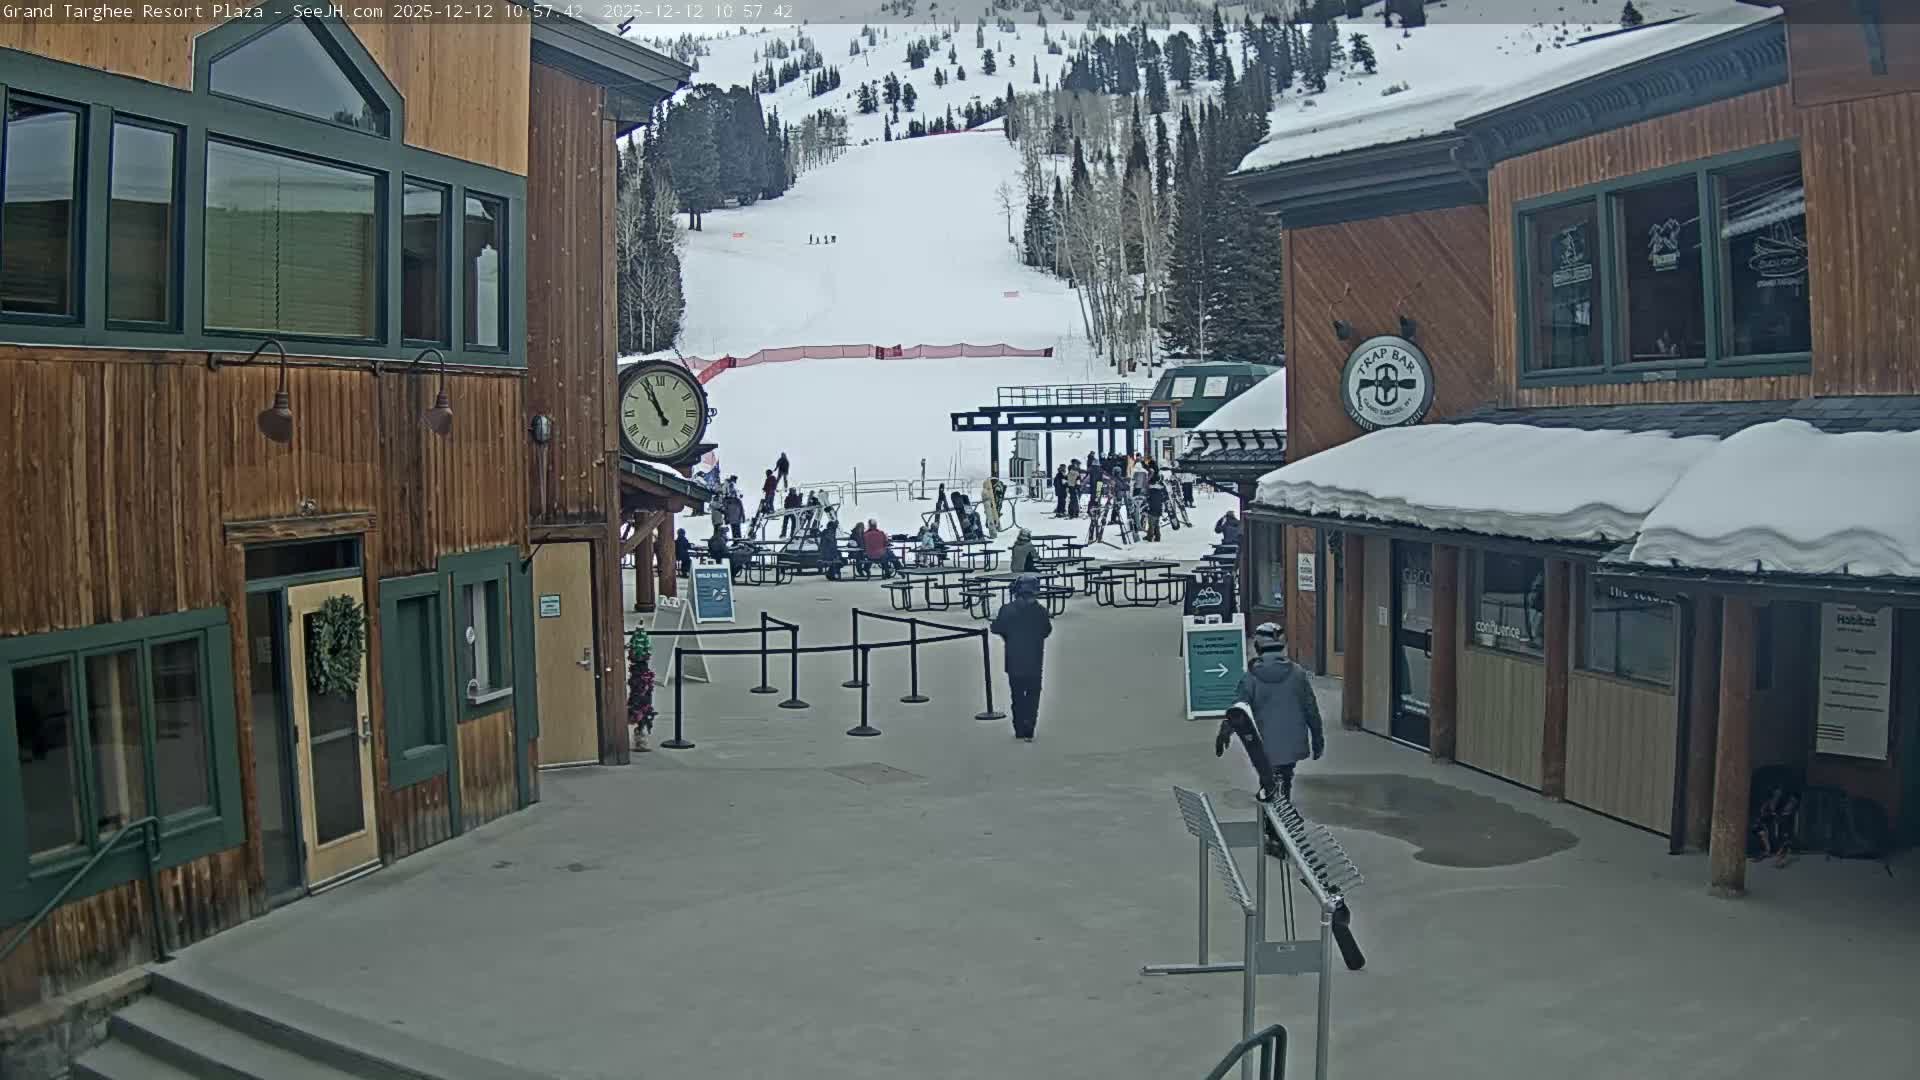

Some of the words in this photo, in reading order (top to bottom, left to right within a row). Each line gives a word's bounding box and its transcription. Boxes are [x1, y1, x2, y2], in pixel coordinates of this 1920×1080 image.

[1357, 348, 1388, 375] TRAP
[1391, 350, 1416, 375] BAR
[1837, 613, 1877, 628] Habitat
